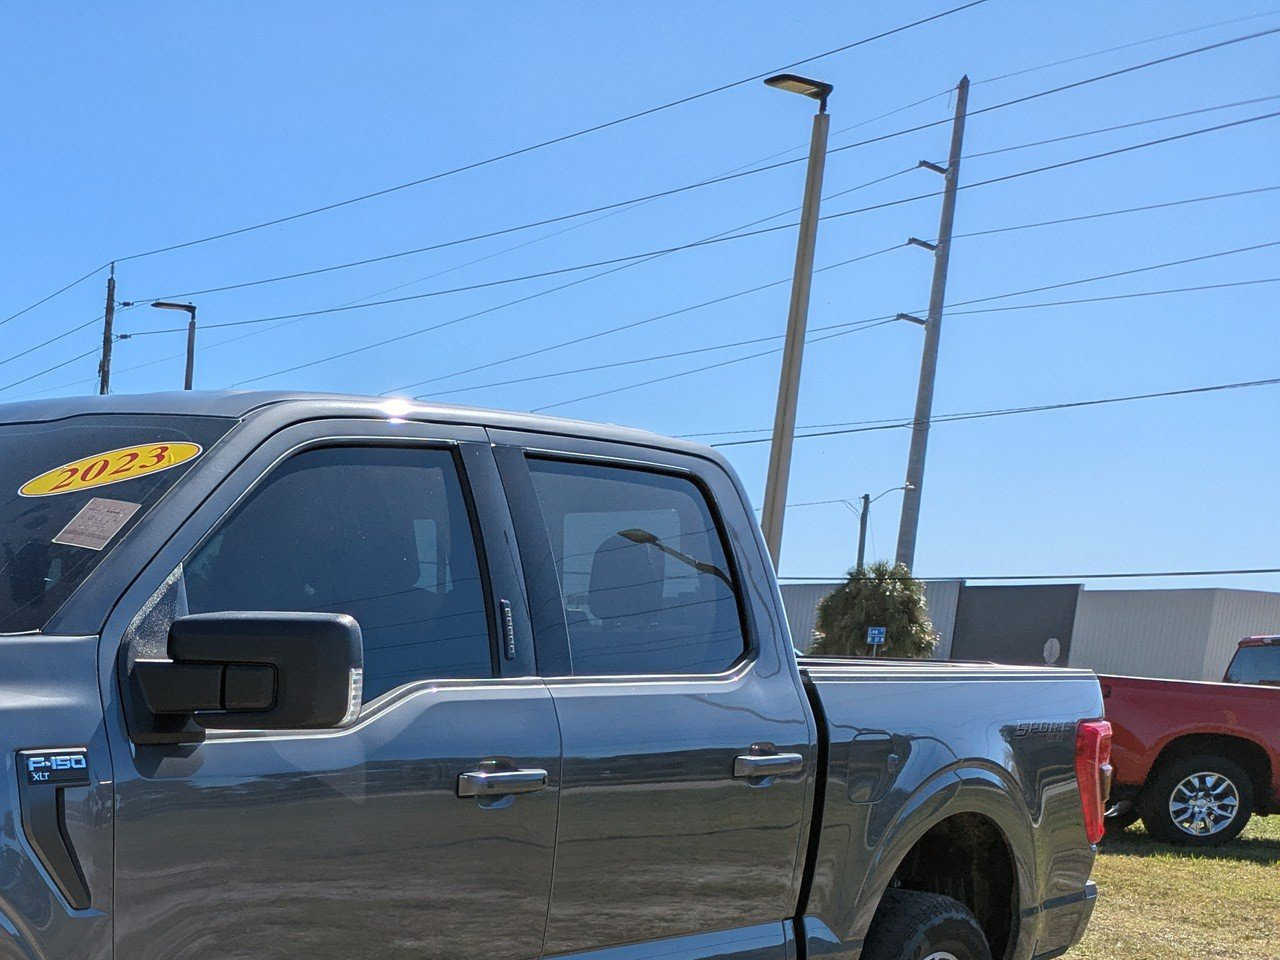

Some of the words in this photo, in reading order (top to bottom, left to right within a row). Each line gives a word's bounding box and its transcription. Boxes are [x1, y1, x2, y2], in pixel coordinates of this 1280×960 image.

[48, 446, 170, 492] 2023
[27, 755, 87, 771] F-150
[31, 772, 50, 781] XLT
